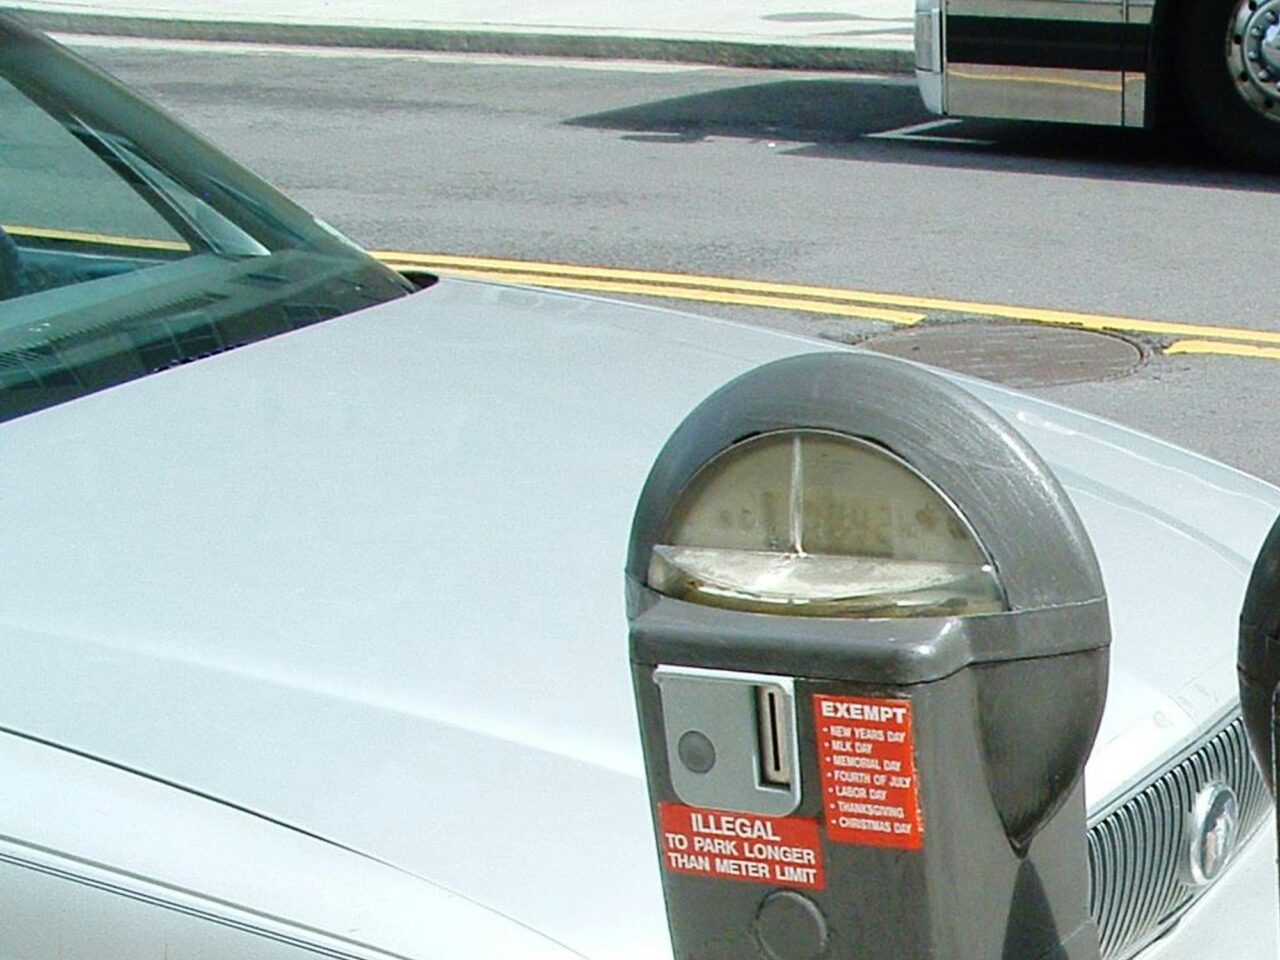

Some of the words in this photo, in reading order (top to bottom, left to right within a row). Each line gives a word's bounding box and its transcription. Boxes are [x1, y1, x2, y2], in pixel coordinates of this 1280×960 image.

[821, 701, 906, 724] EXEMPT
[830, 726, 851, 737] NEW
[854, 728, 884, 741] YEARS
[887, 731, 905, 743] DAY
[831, 740, 852, 752] MLK
[855, 742, 872, 754] DAY
[833, 755, 881, 769] MEMORIAL
[883, 760, 901, 771] DAY
[834, 770, 871, 783] FOURTH
[873, 775, 886, 784] OF
[889, 776, 911, 788] JULY
[835, 786, 867, 798] LABOR
[869, 789, 886, 800] DAY
[837, 801, 904, 818] THANKSGIVING
[691, 813, 781, 841] ILLEGAL
[839, 817, 891, 832] CHRISTMAS
[893, 822, 912, 834] DAY
[665, 833, 688, 850] TO
[694, 837, 738, 856] PARK
[744, 843, 815, 864] LONGER
[668, 853, 709, 871] THAN
[715, 858, 770, 878] METER
[775, 865, 816, 884] LIMIT
